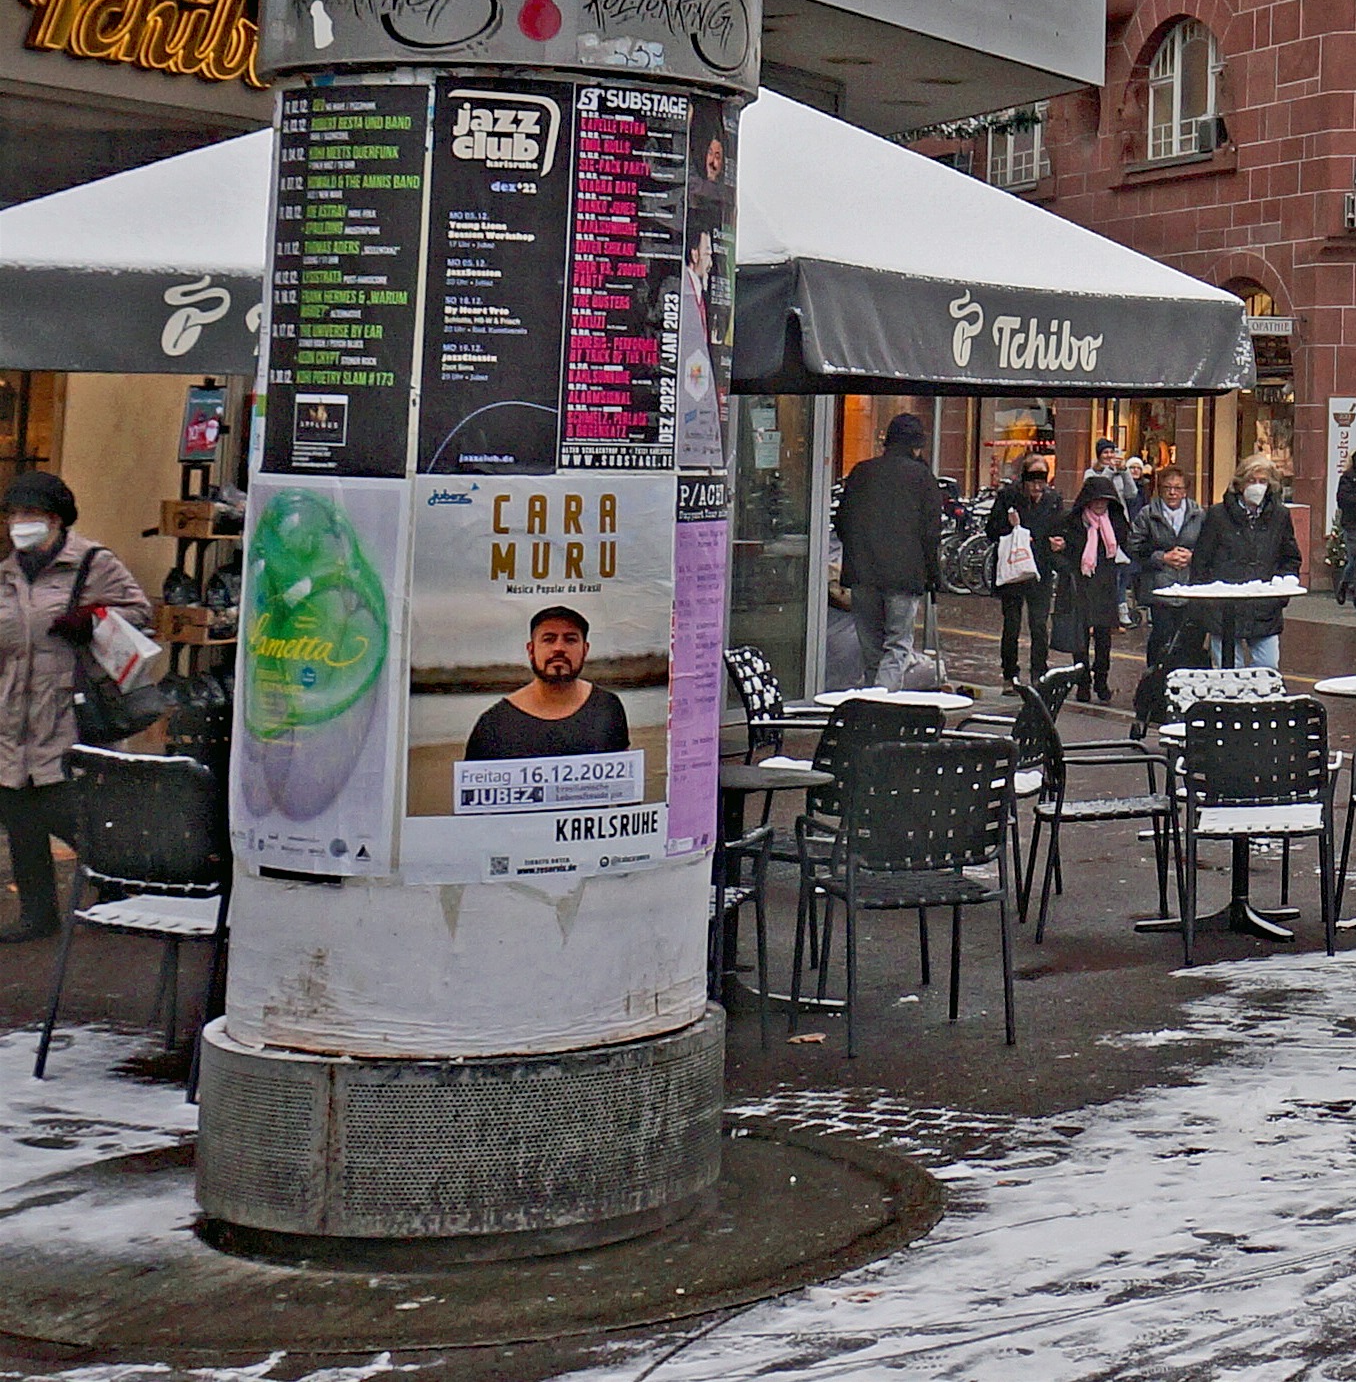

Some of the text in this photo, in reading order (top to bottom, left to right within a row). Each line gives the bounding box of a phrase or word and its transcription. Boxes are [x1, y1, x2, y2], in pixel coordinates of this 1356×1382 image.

[605, 89, 688, 116] SUBSTAGE
[452, 102, 540, 136] jazz
[452, 131, 540, 161] club
[663, 292, 679, 329] 2023
[1251, 321, 1290, 332] OPATHIE
[661, 332, 678, 363] JAN
[991, 315, 1104, 373] Tchibo
[660, 377, 676, 413] 2022
[658, 417, 675, 443] DEZ
[561, 454, 673, 467] WWW.SUBSTAGE.DE
[493, 493, 617, 535] CARA
[490, 540, 617, 580] MURU
[461, 761, 626, 785] Freitag 16.12.2022
[469, 787, 534, 805] JUBEZ
[555, 810, 659, 842] KARLSRUHE
